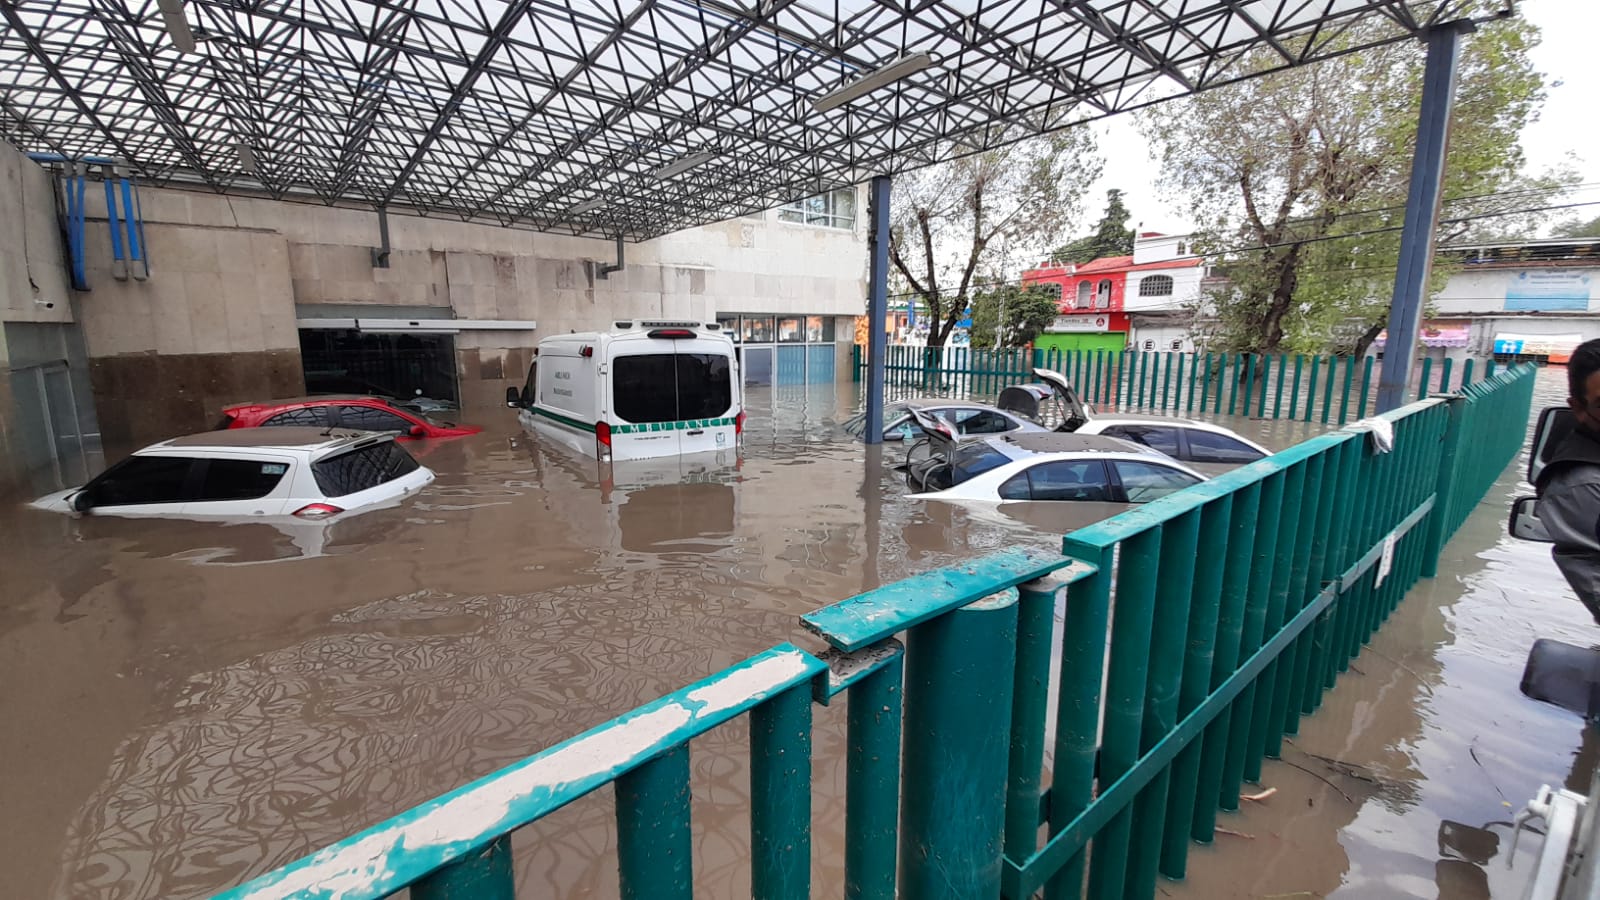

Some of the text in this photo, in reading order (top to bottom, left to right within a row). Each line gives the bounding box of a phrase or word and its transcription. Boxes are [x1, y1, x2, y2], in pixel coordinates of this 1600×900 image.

[1145, 341, 1153, 350] E
[1173, 341, 1180, 350] E
[616, 417, 733, 434] AMBULANCIA
